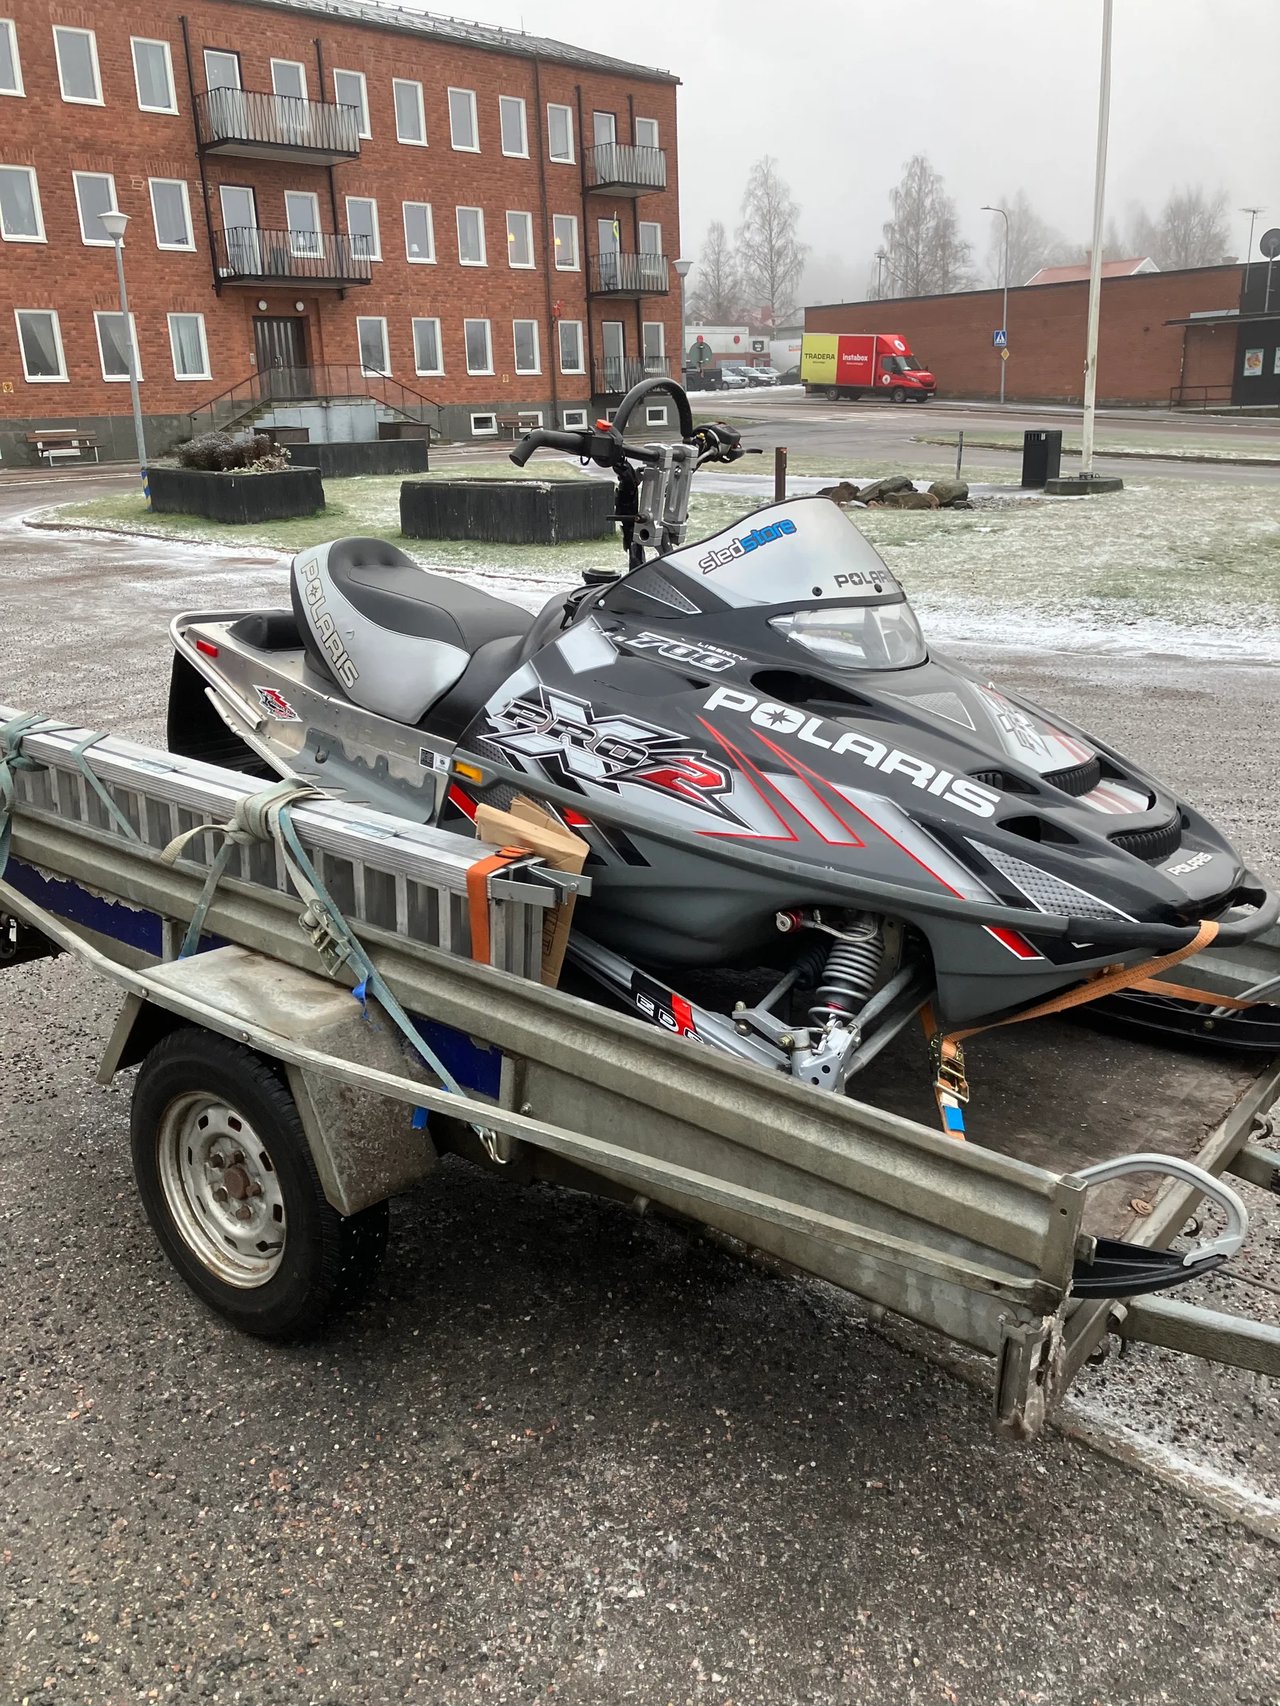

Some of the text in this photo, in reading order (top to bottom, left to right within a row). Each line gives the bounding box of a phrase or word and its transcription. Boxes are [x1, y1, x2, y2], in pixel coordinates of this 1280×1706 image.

[699, 518, 797, 574] sledstore
[301, 557, 360, 690] POLARIS
[615, 631, 736, 672] 700
[697, 641, 748, 661] LIBERTY
[492, 697, 650, 769] PRO
[702, 686, 1001, 818] POLARIS
